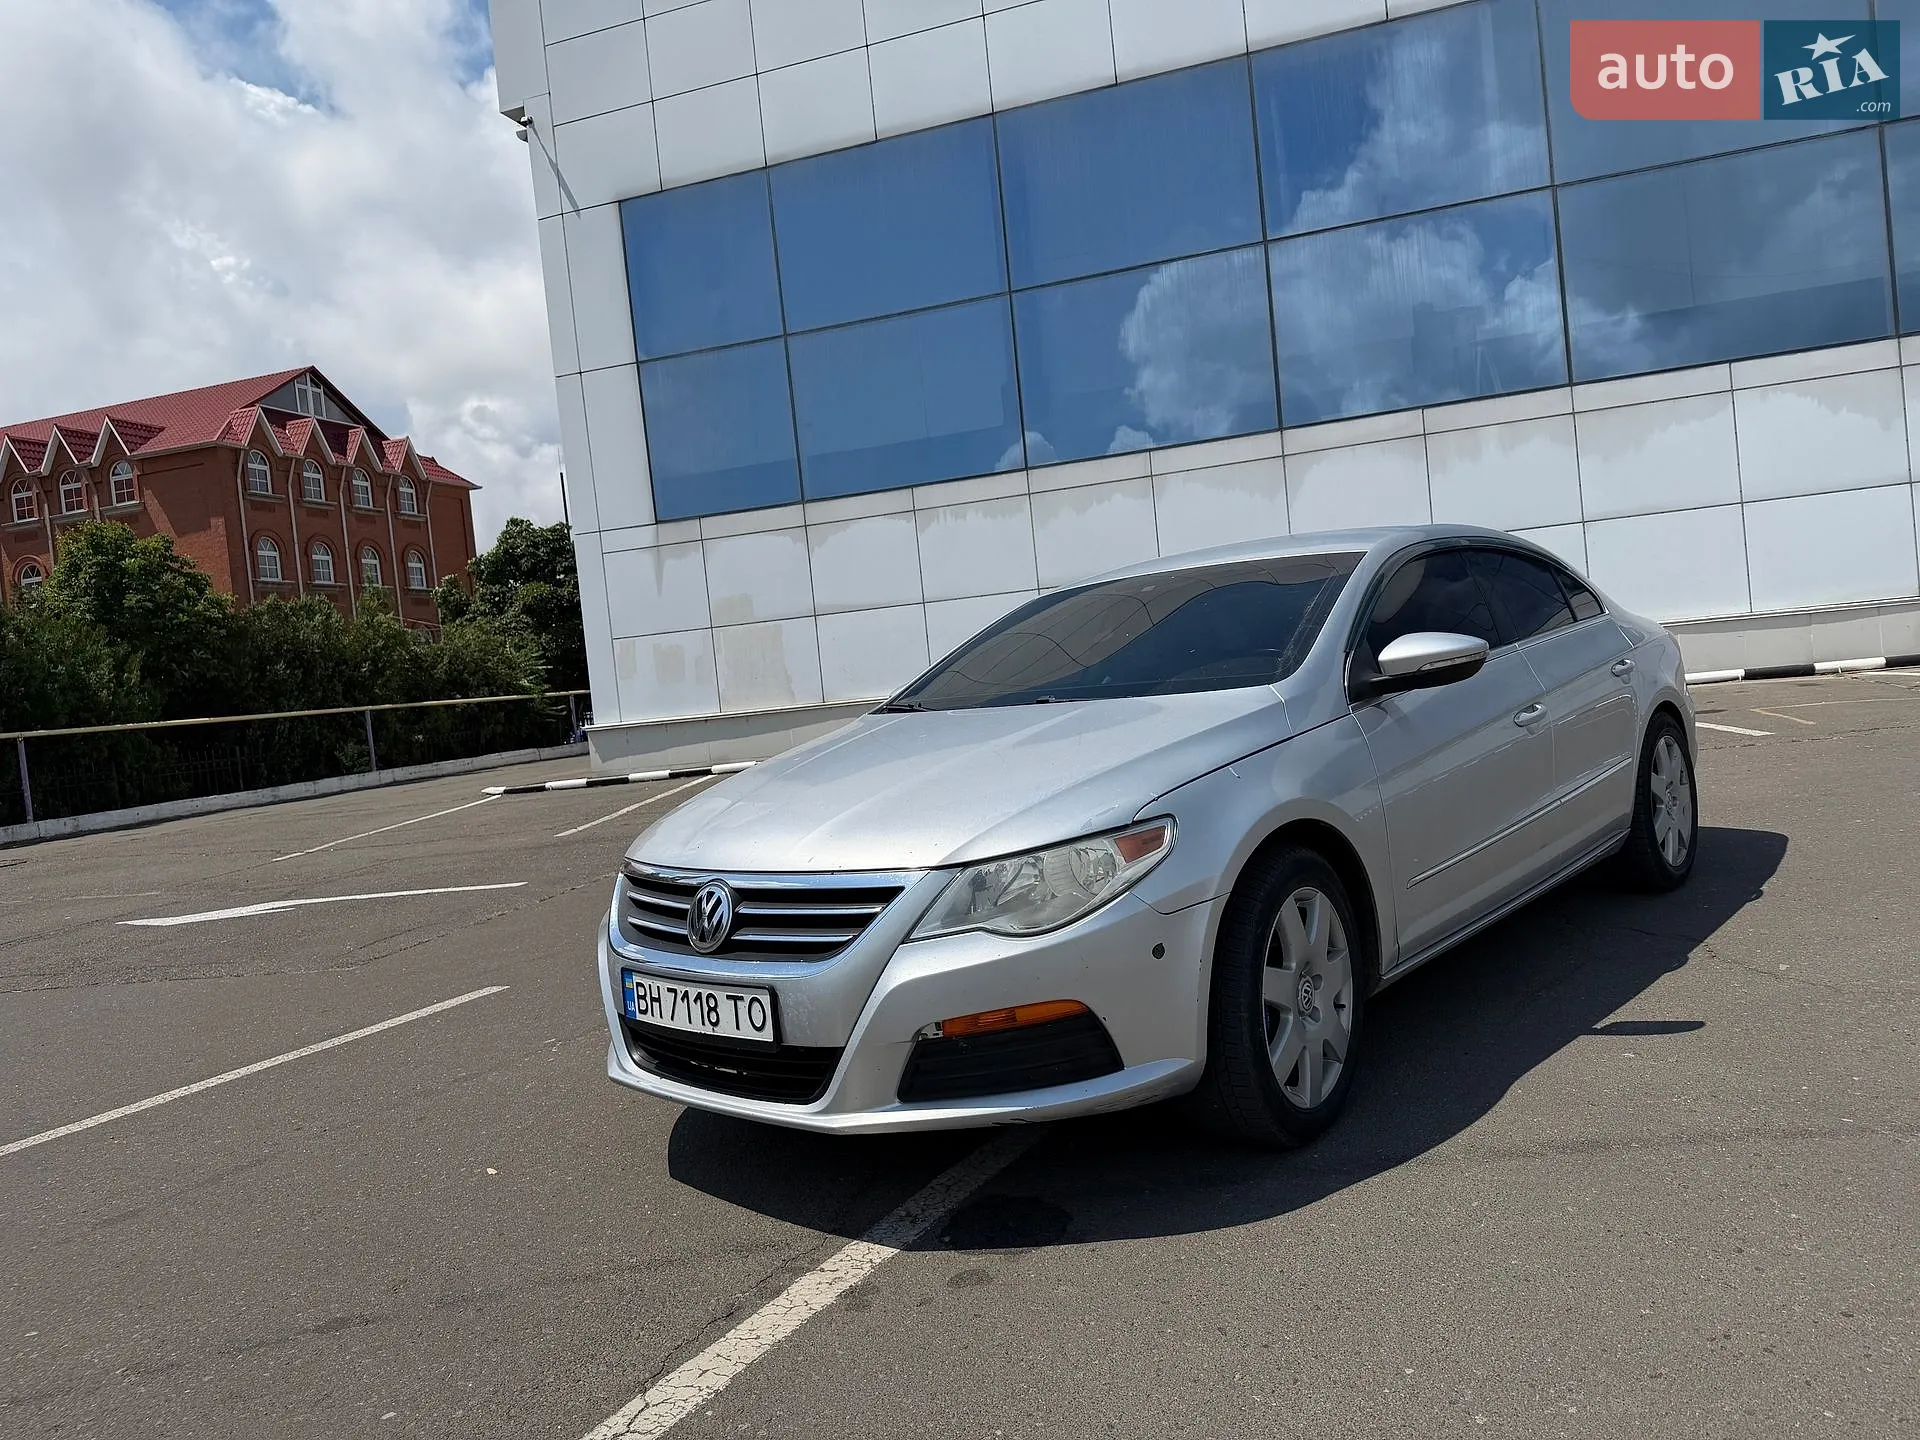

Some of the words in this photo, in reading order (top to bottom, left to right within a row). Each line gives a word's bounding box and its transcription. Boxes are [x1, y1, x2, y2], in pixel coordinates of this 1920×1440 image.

[627, 1001, 636, 1012] UA
[635, 981, 663, 1019] BH
[667, 986, 720, 1027] 7118
[725, 994, 767, 1032] TO
